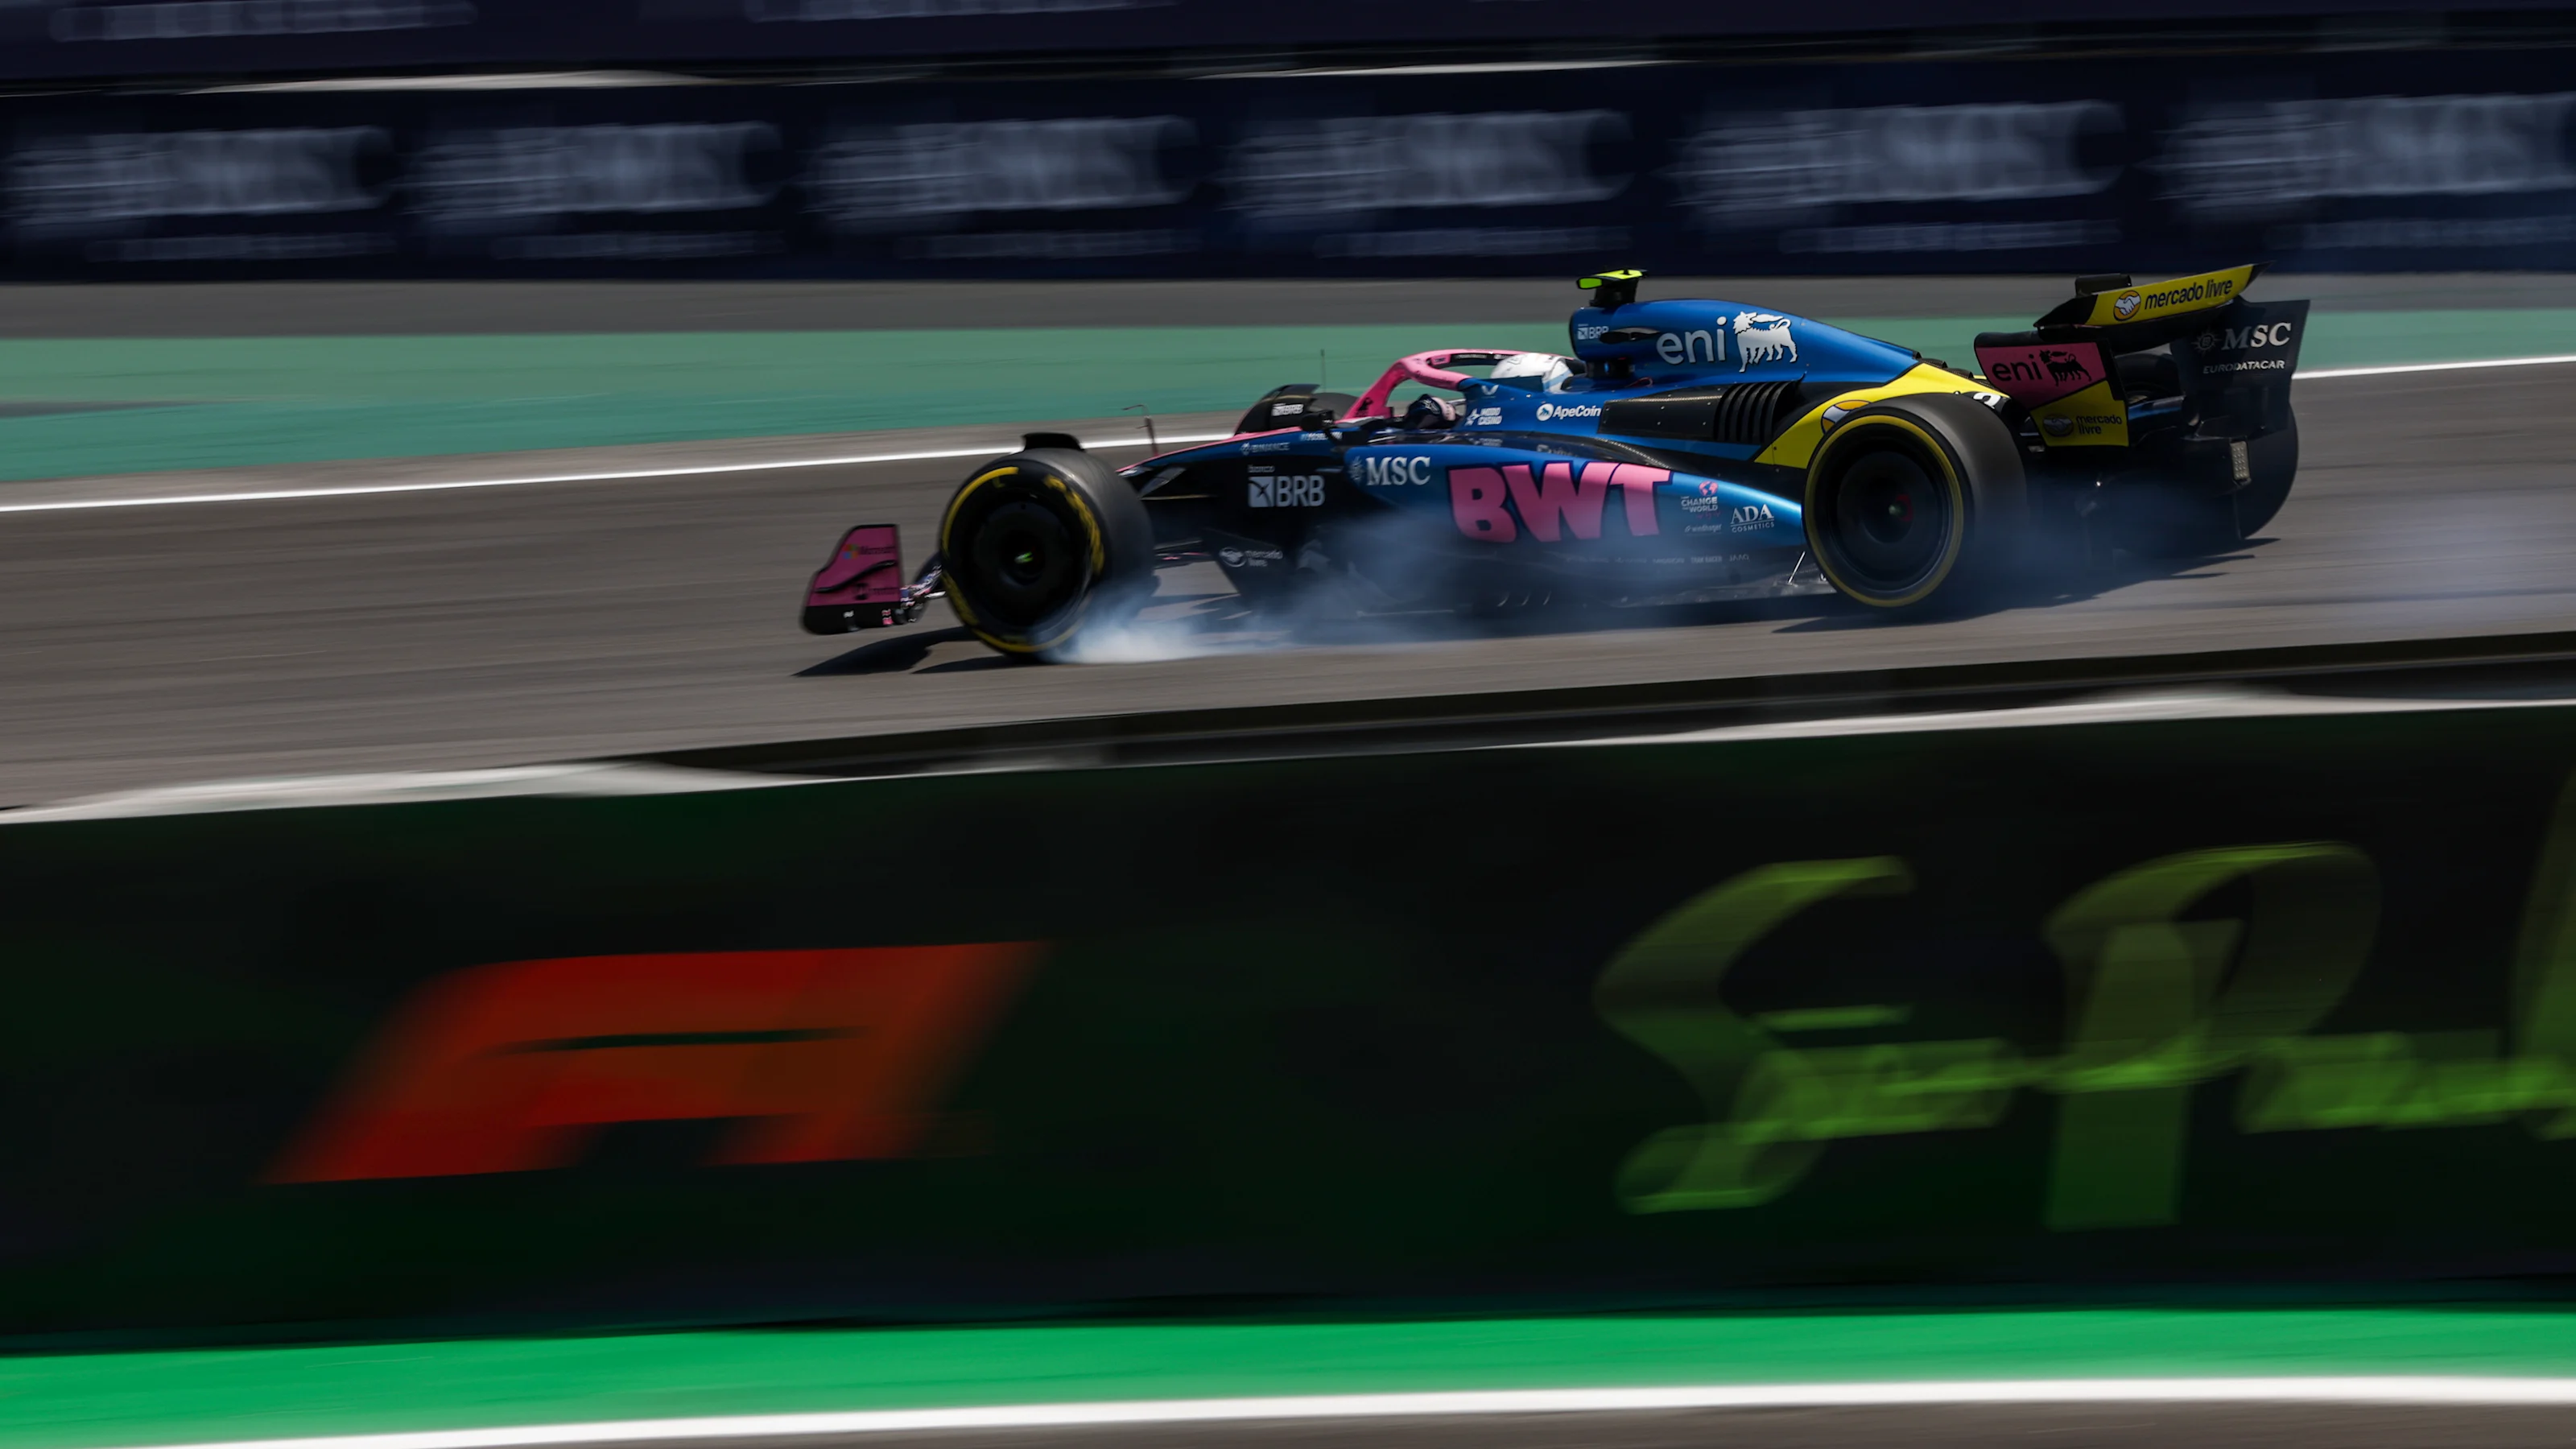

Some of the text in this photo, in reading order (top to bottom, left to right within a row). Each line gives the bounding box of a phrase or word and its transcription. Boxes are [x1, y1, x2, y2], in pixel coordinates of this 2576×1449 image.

[2145, 279, 2233, 311] mercado livre
[1655, 316, 1727, 365] eni
[2221, 322, 2292, 351] MSC
[1992, 354, 2043, 382] eni
[2202, 360, 2285, 374] EURODATACAR
[1552, 405, 1603, 419] ApeCoin
[2076, 415, 2123, 424] mercado
[2079, 423, 2102, 435] livre
[1365, 456, 1431, 486] MSC
[1276, 475, 1326, 507] BRB
[1447, 460, 1672, 543] BWT
[1681, 497, 1718, 507] CHANGE
[1689, 505, 1719, 513] WORLD
[1730, 503, 1775, 524] ADA
[1732, 522, 1775, 533] COSMETICS
